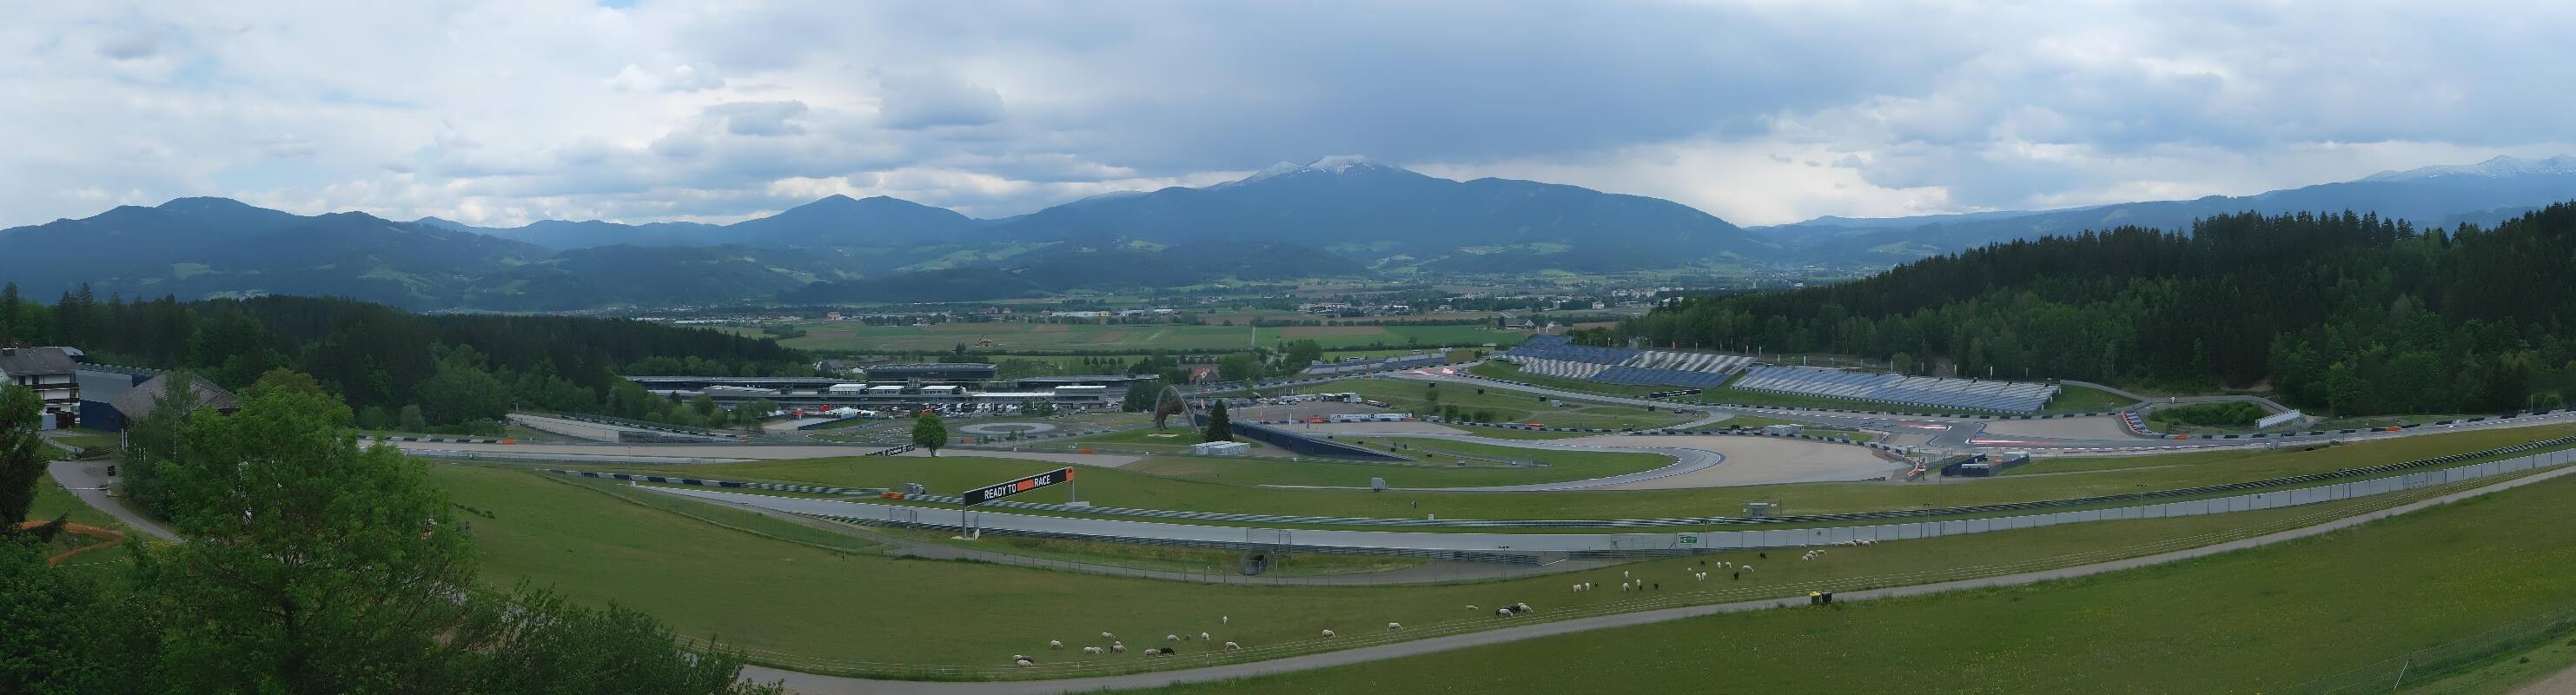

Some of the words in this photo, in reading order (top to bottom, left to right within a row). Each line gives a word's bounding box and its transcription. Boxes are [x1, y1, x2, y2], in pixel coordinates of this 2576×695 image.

[984, 486, 1006, 500] READY
[1008, 484, 1016, 493] TO
[1034, 475, 1050, 487] RACE
